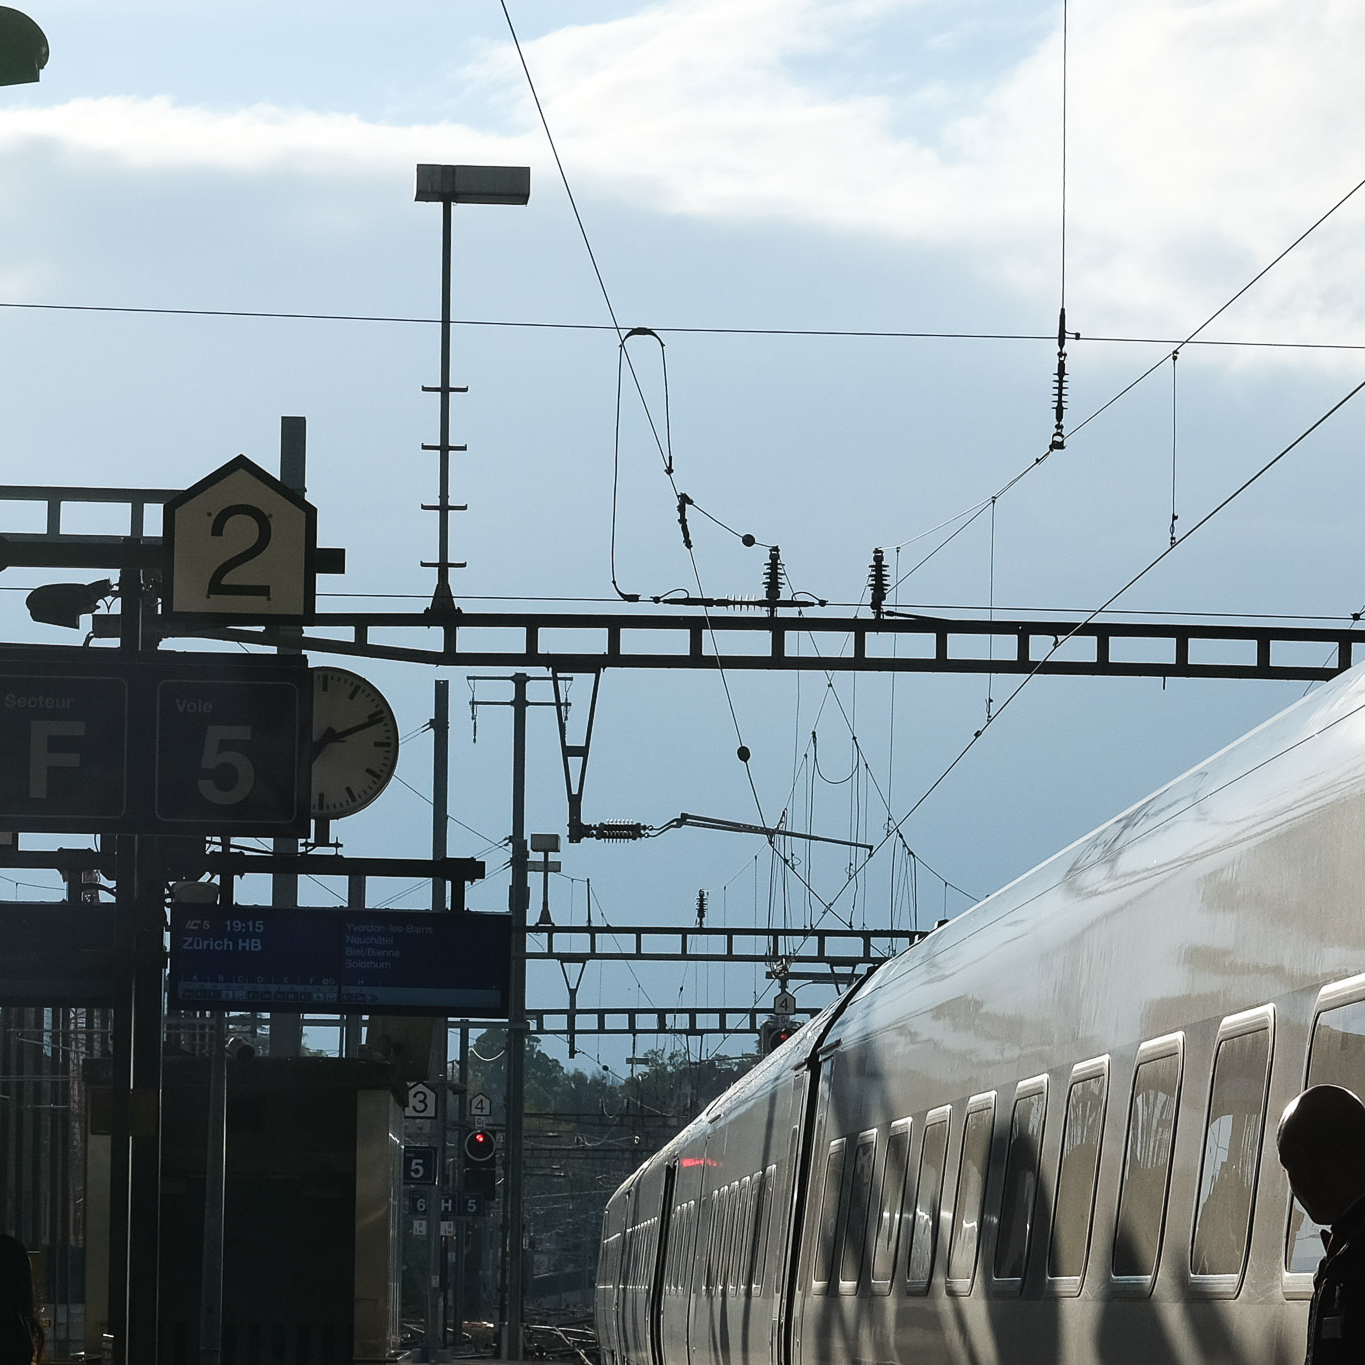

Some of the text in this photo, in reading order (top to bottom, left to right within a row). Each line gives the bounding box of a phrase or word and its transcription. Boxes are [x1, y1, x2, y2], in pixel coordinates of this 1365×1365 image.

[206, 503, 273, 600] 2
[3, 692, 73, 712] Secteur
[175, 697, 213, 715] Voie
[28, 719, 84, 800] F
[195, 723, 256, 807] 5
[224, 919, 265, 933] 19:15
[182, 936, 262, 952] Zürich HB
[345, 935, 395, 945] Neuchâtel
[345, 947, 401, 958] Biel/Bienne
[345, 959, 392, 970] Solothurn
[779, 997, 790, 1011] 4
[412, 1090, 428, 1114] 3
[474, 1098, 486, 1113] 4
[409, 1158, 424, 1178] 5
[416, 1198, 426, 1212] 6
[440, 1198, 452, 1212] H
[467, 1199, 477, 1213] 5
